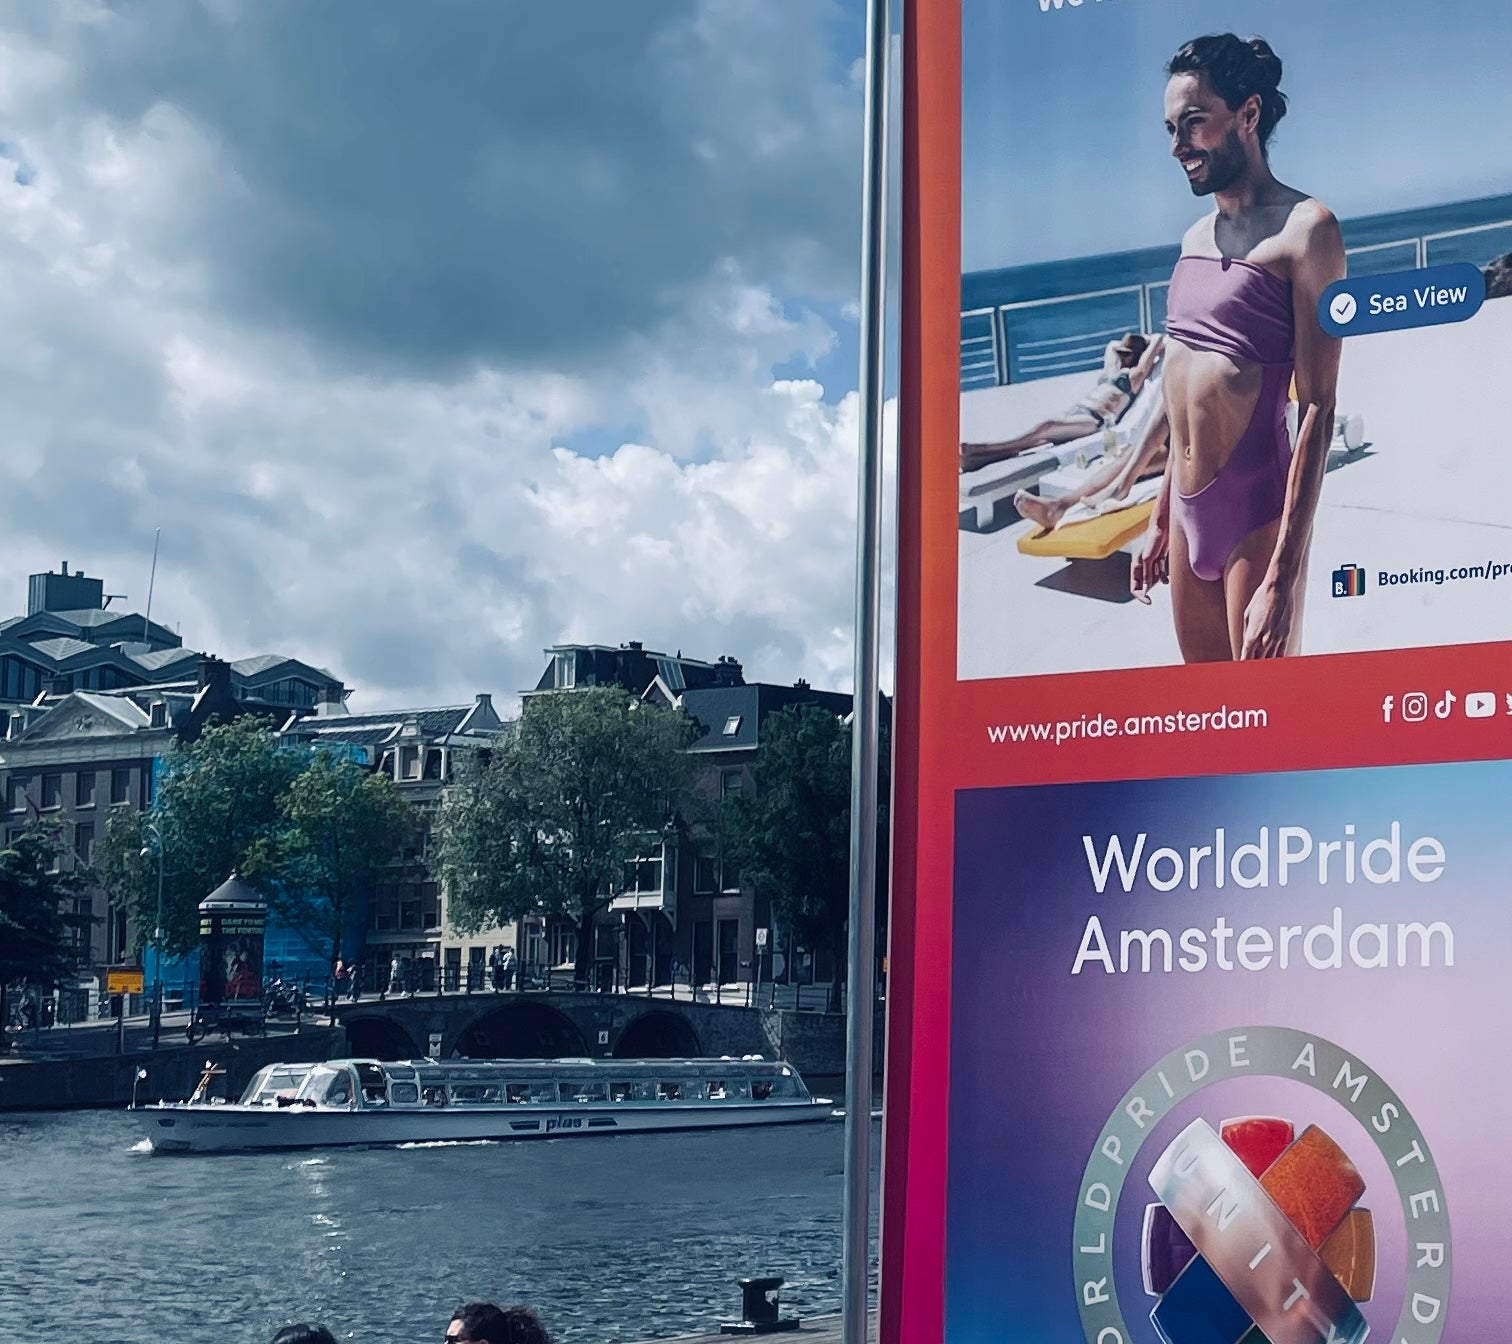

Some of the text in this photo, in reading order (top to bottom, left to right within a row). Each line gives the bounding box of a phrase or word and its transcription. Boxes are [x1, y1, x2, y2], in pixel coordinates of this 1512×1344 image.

[1369, 283, 1468, 317] Sea View
[987, 703, 1268, 745] www.pride.amsterdam
[1082, 820, 1447, 894] WorldPride
[1071, 906, 1455, 975] Amsterdam
